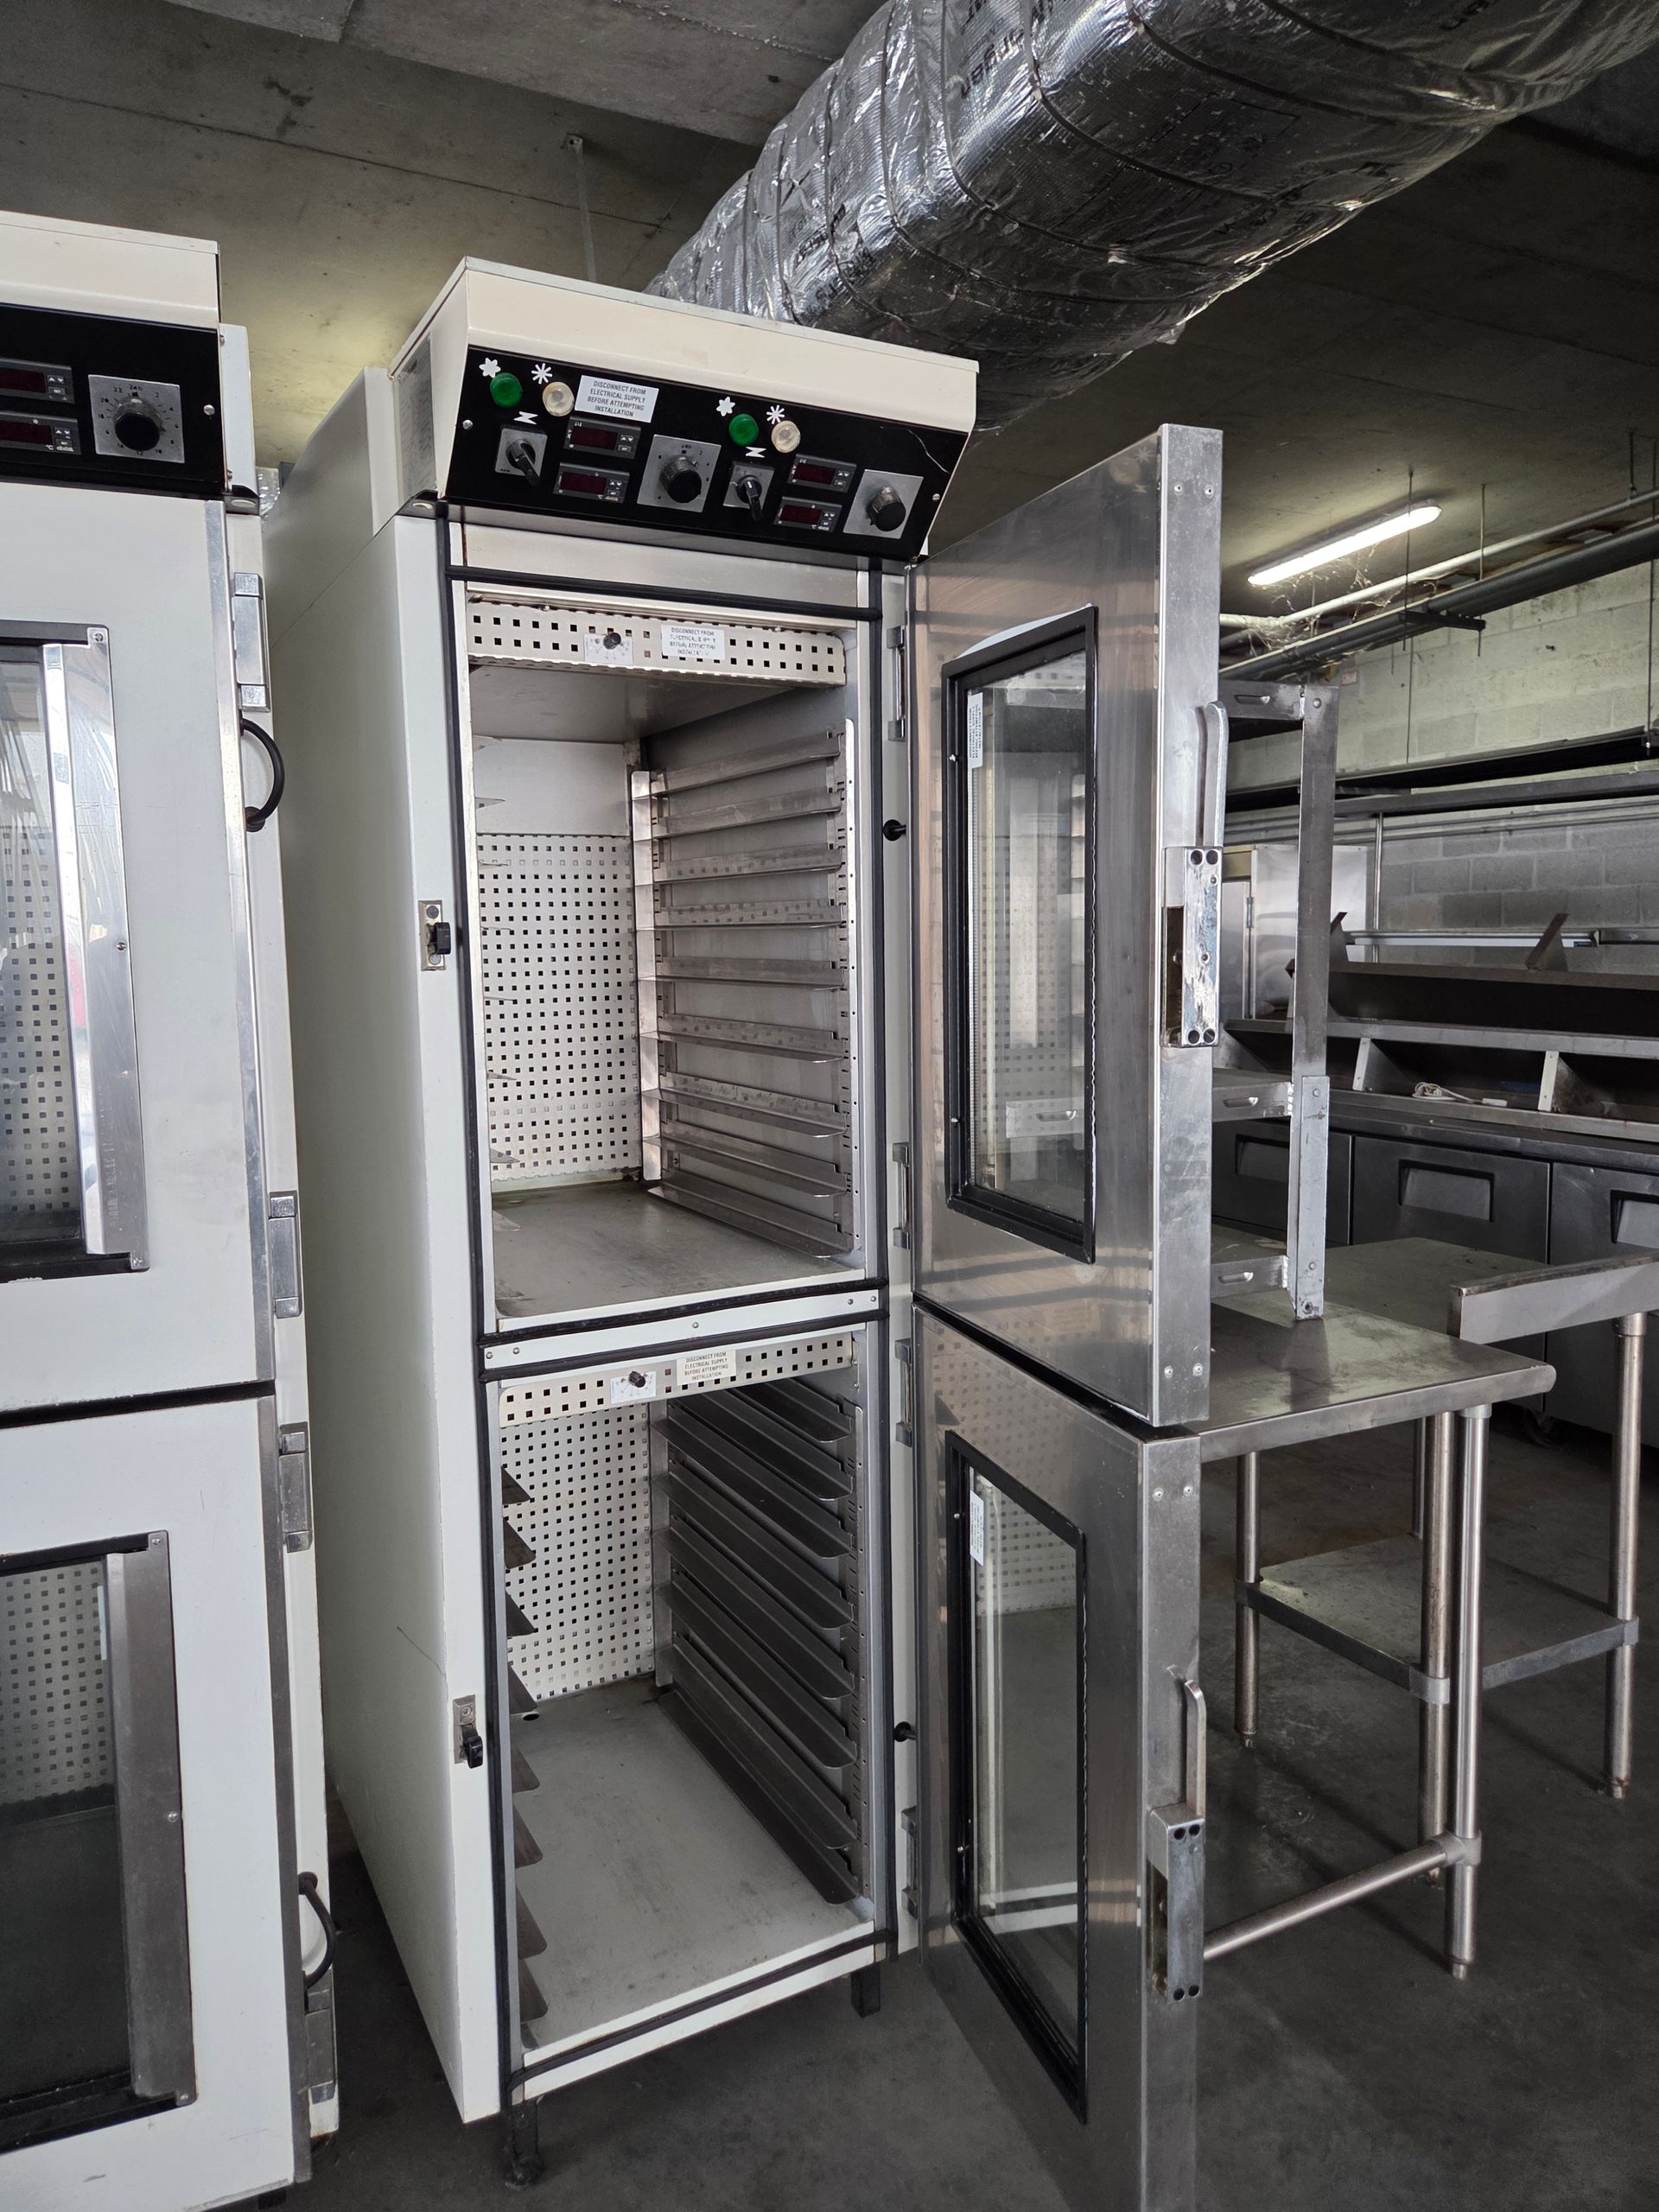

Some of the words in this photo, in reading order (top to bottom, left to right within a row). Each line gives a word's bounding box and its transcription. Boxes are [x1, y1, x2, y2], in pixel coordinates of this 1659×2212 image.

[594, 381, 628, 392] DISCONNECT
[590, 388, 622, 399] ELECTRICAL
[625, 394, 646, 403] SUPPLY
[588, 396, 609, 405] BEFORE
[609, 400, 645, 411] ATTEMPTING
[594, 405, 634, 417] INSTALLATION
[686, 1353, 713, 1363] DISCONNECT
[702, 1363, 728, 1372] ATTEMPTING
[692, 1371, 721, 1380] INSTALLATION
